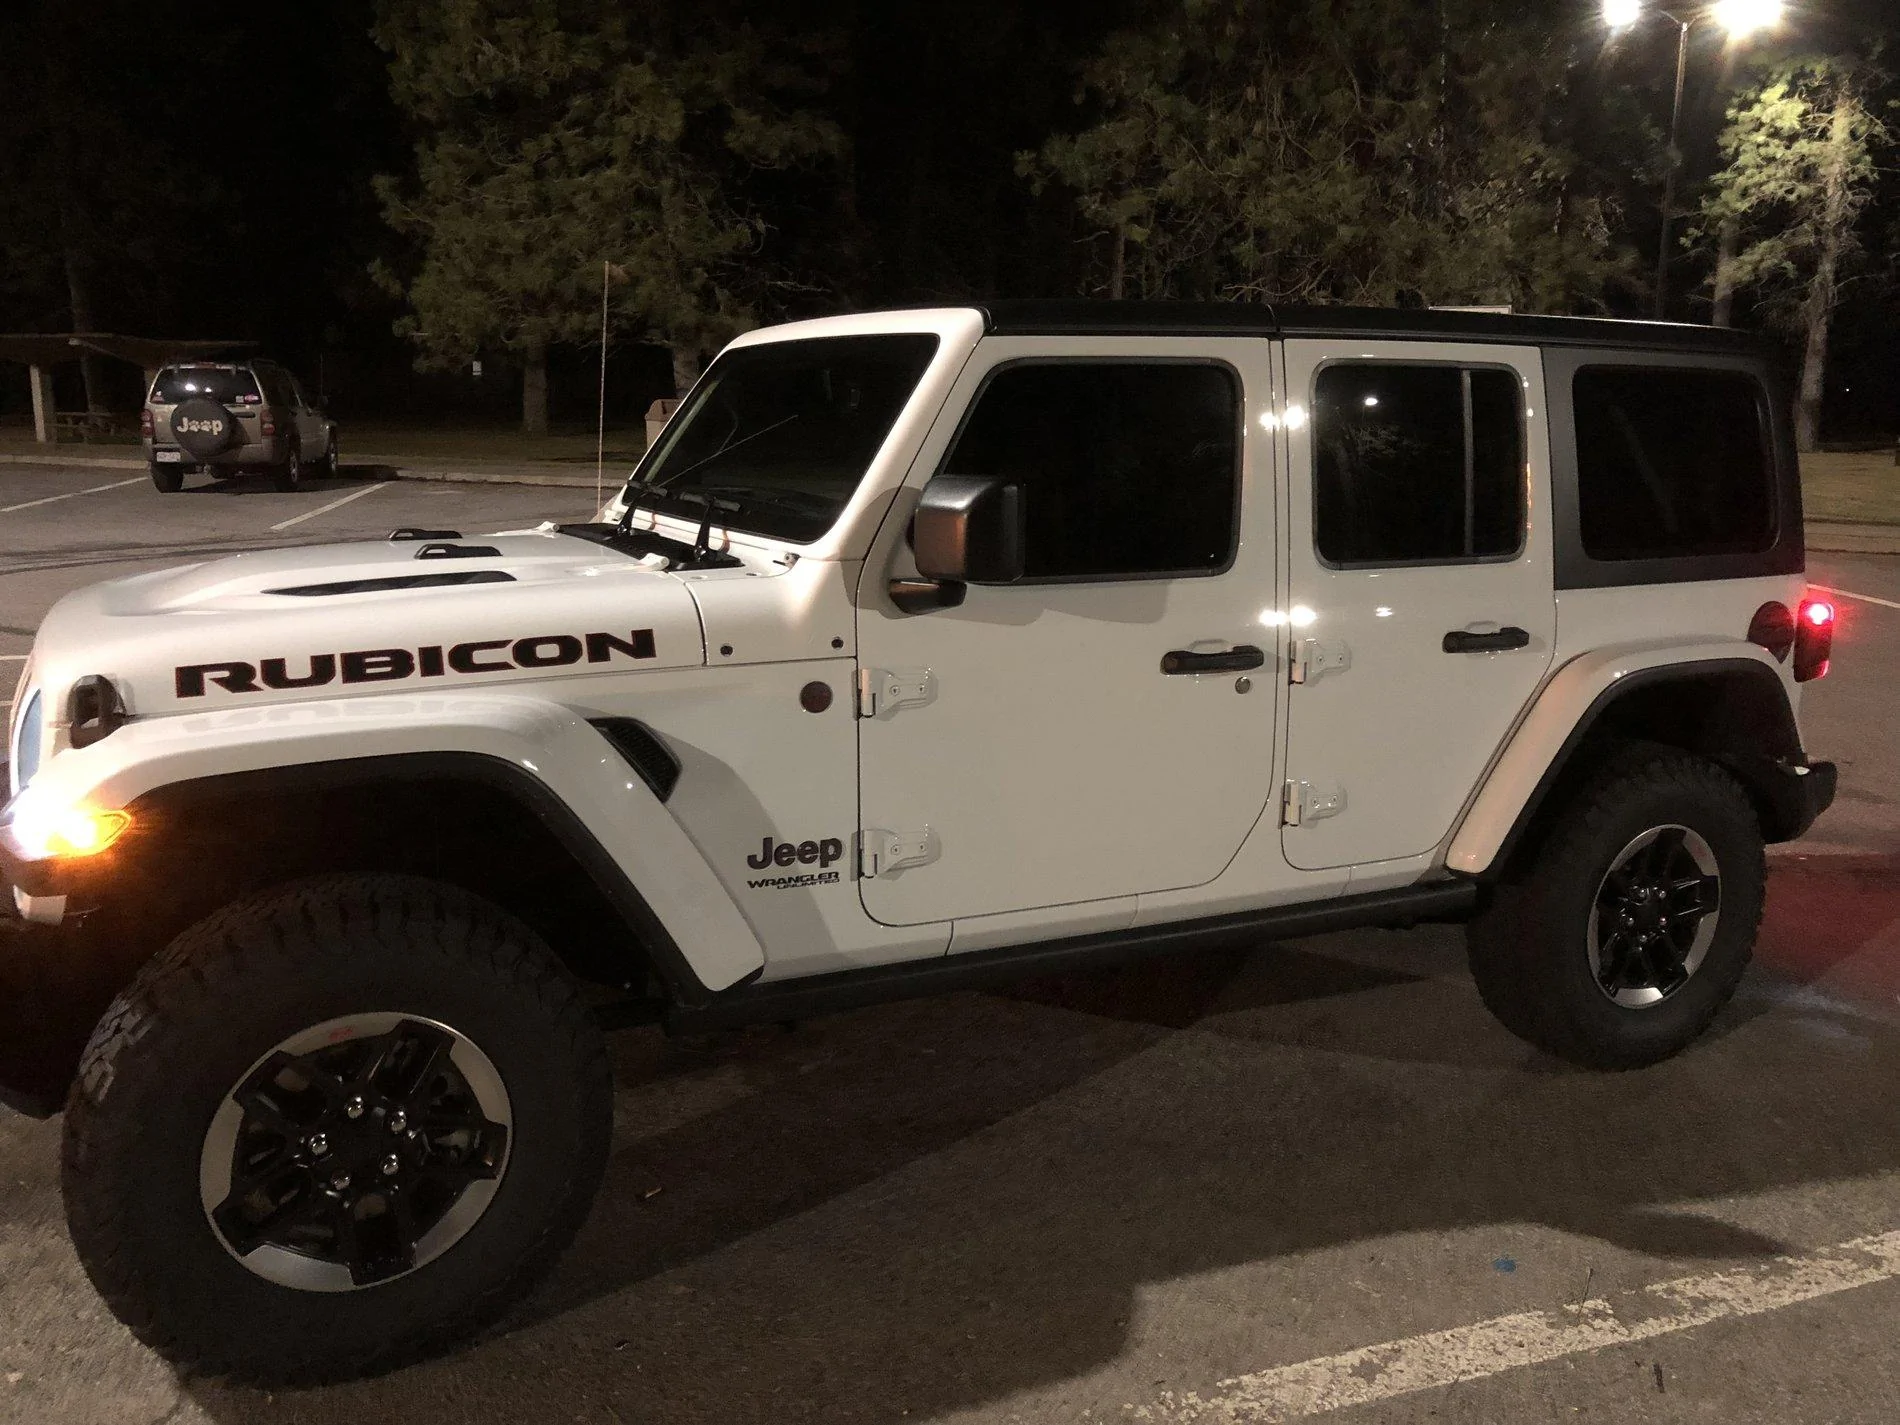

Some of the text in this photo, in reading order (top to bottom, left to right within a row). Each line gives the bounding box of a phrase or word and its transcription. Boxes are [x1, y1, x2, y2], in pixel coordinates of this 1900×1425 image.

[175, 628, 657, 699] RUBICON
[747, 837, 843, 870] Jeep
[747, 871, 840, 889] WRANGLER
[777, 878, 840, 889] UNLIMITED
